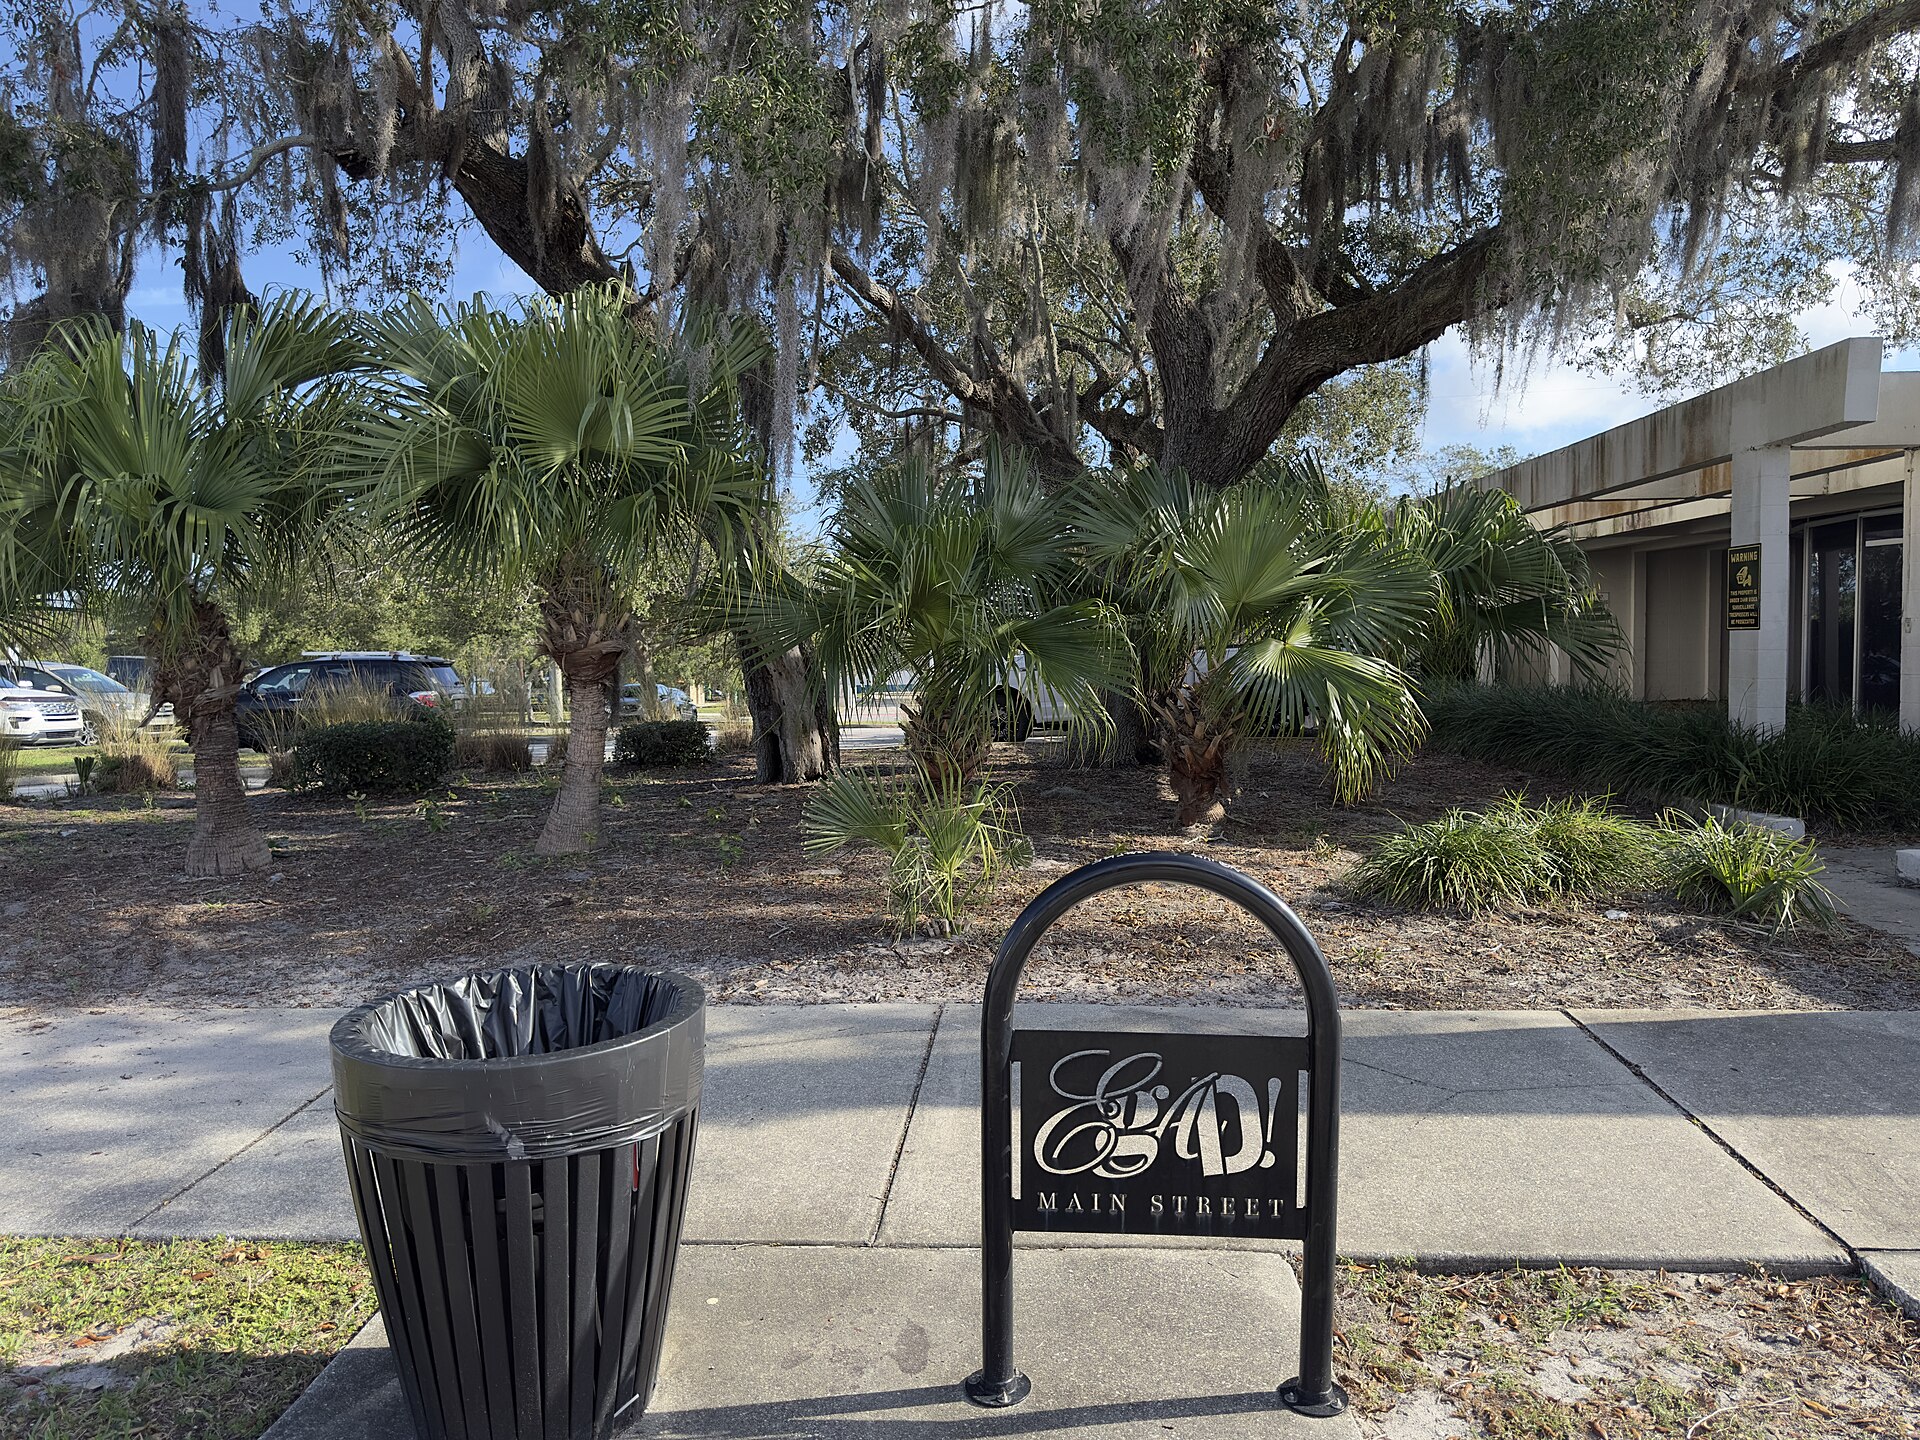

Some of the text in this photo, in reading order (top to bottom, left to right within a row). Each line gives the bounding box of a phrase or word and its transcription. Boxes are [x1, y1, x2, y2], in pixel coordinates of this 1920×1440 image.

[1731, 552, 1758, 562] WARNING
[1037, 1192, 1284, 1218] MAIN STREET
